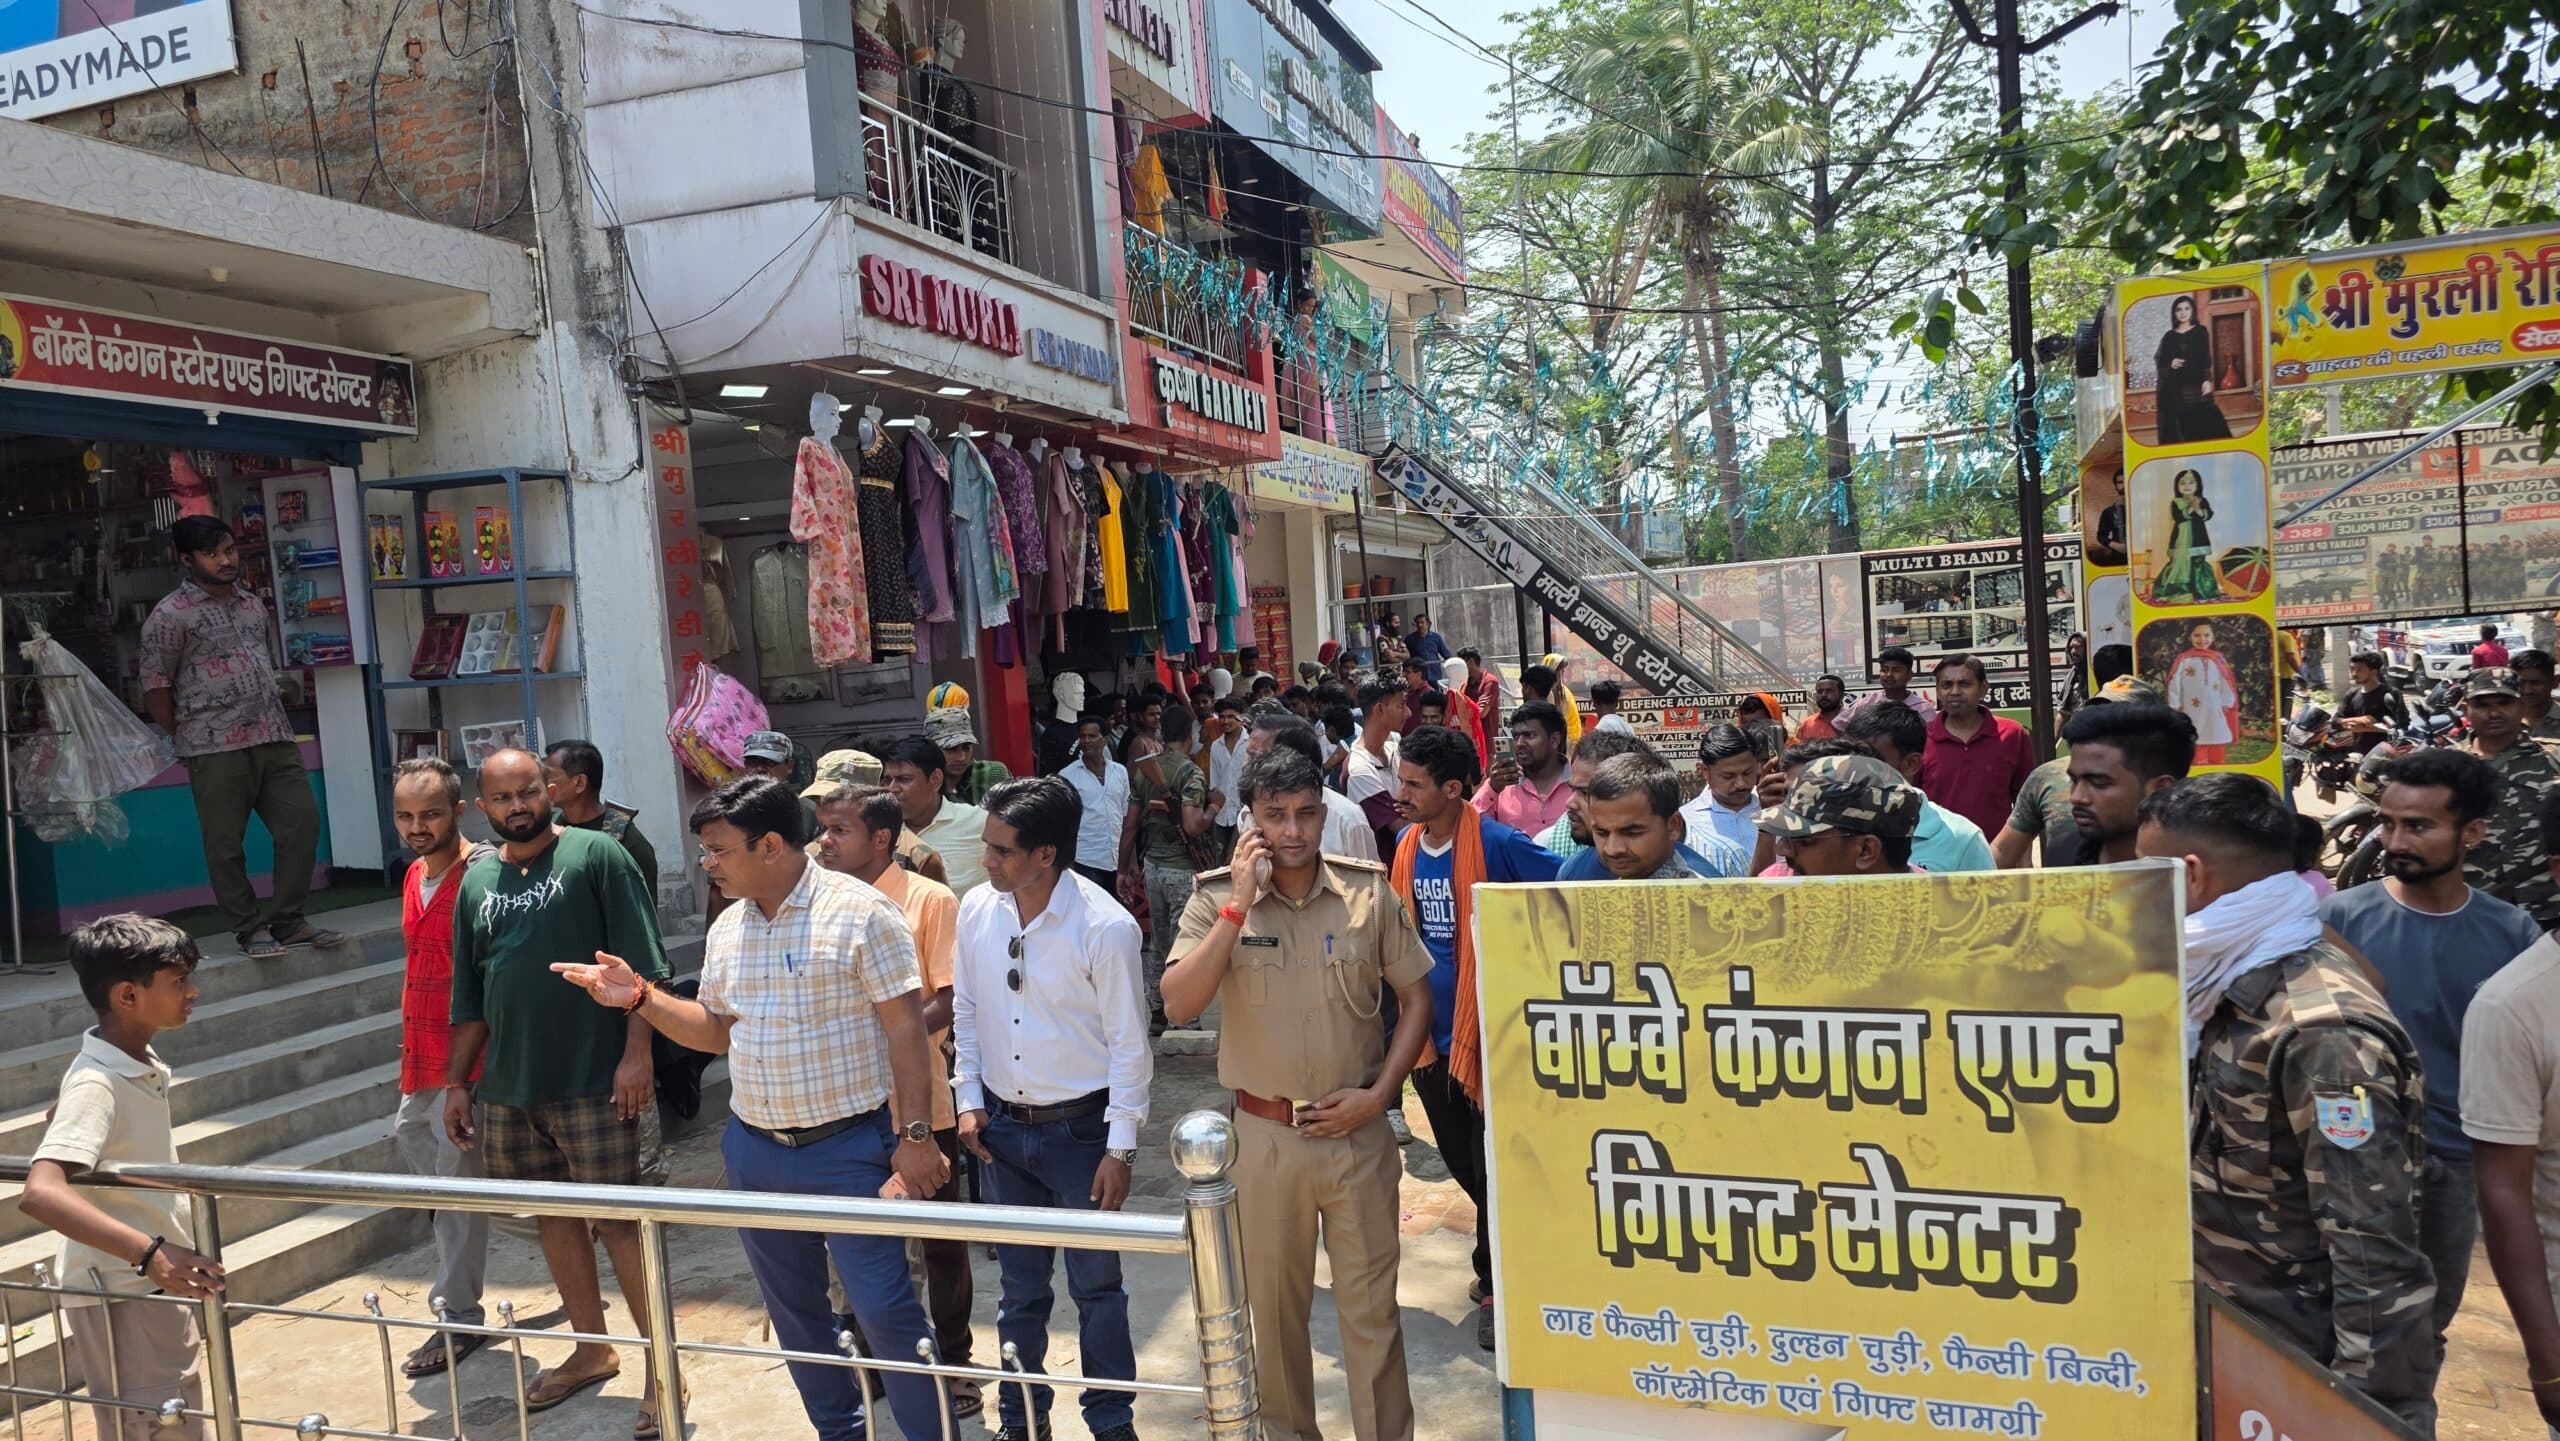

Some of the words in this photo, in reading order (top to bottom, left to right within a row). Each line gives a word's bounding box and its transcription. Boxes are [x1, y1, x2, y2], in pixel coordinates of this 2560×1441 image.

[862, 254, 926, 327] SRI
[922, 274, 1023, 357] MURLI
[2321, 269, 2374, 330] श्री
[2382, 253, 2502, 340] मुरली
[31, 314, 93, 371] बॉम्बे
[96, 322, 167, 381] कंगन
[169, 336, 221, 388] स्टोर
[222, 353, 263, 396] एण्ड
[265, 346, 320, 402] गिफ्ट
[319, 356, 371, 408] सेन्टर
[2275, 362, 2300, 378] हर
[2304, 355, 2362, 375] ग्राहक
[2366, 349, 2391, 367] की
[2397, 343, 2448, 363] पहली
[2453, 339, 2501, 357] पसंद
[652, 425, 687, 456] श्री
[1201, 372, 1269, 434] GARMENT
[1869, 557, 1933, 573] MULTI
[1939, 550, 2010, 568] BRAND
[2016, 544, 2080, 562] SOE
[1535, 570, 1581, 612] मल्टी
[1612, 633, 1636, 666] शू
[1635, 650, 1678, 688] स्टोर
[1623, 698, 1674, 711] DEFENCE
[1678, 695, 1733, 708] ACADEMY
[2010, 681, 2031, 701] स्टो
[1525, 960, 1690, 1099] बॉम्बे
[1705, 965, 1931, 1115] कंगन
[1947, 1010, 2124, 1133] एण्ड
[1587, 1129, 1815, 1281] गिफ्ट
[1819, 1142, 2081, 1305] सेन्टर
[1542, 1305, 1595, 1339] लाह
[1602, 1302, 1679, 1345] फैन्सी
[1767, 1323, 1850, 1365] दुल्हन
[1942, 1340, 2036, 1383] फैन्सी
[2045, 1343, 2148, 1396] बिन्दी,
[1632, 1364, 1768, 1407] कॉस्मेटिक
[1776, 1377, 1823, 1416] एवं
[1831, 1381, 1917, 1428] गिफ्ट
[1925, 1398, 2043, 1440] सामग्री
